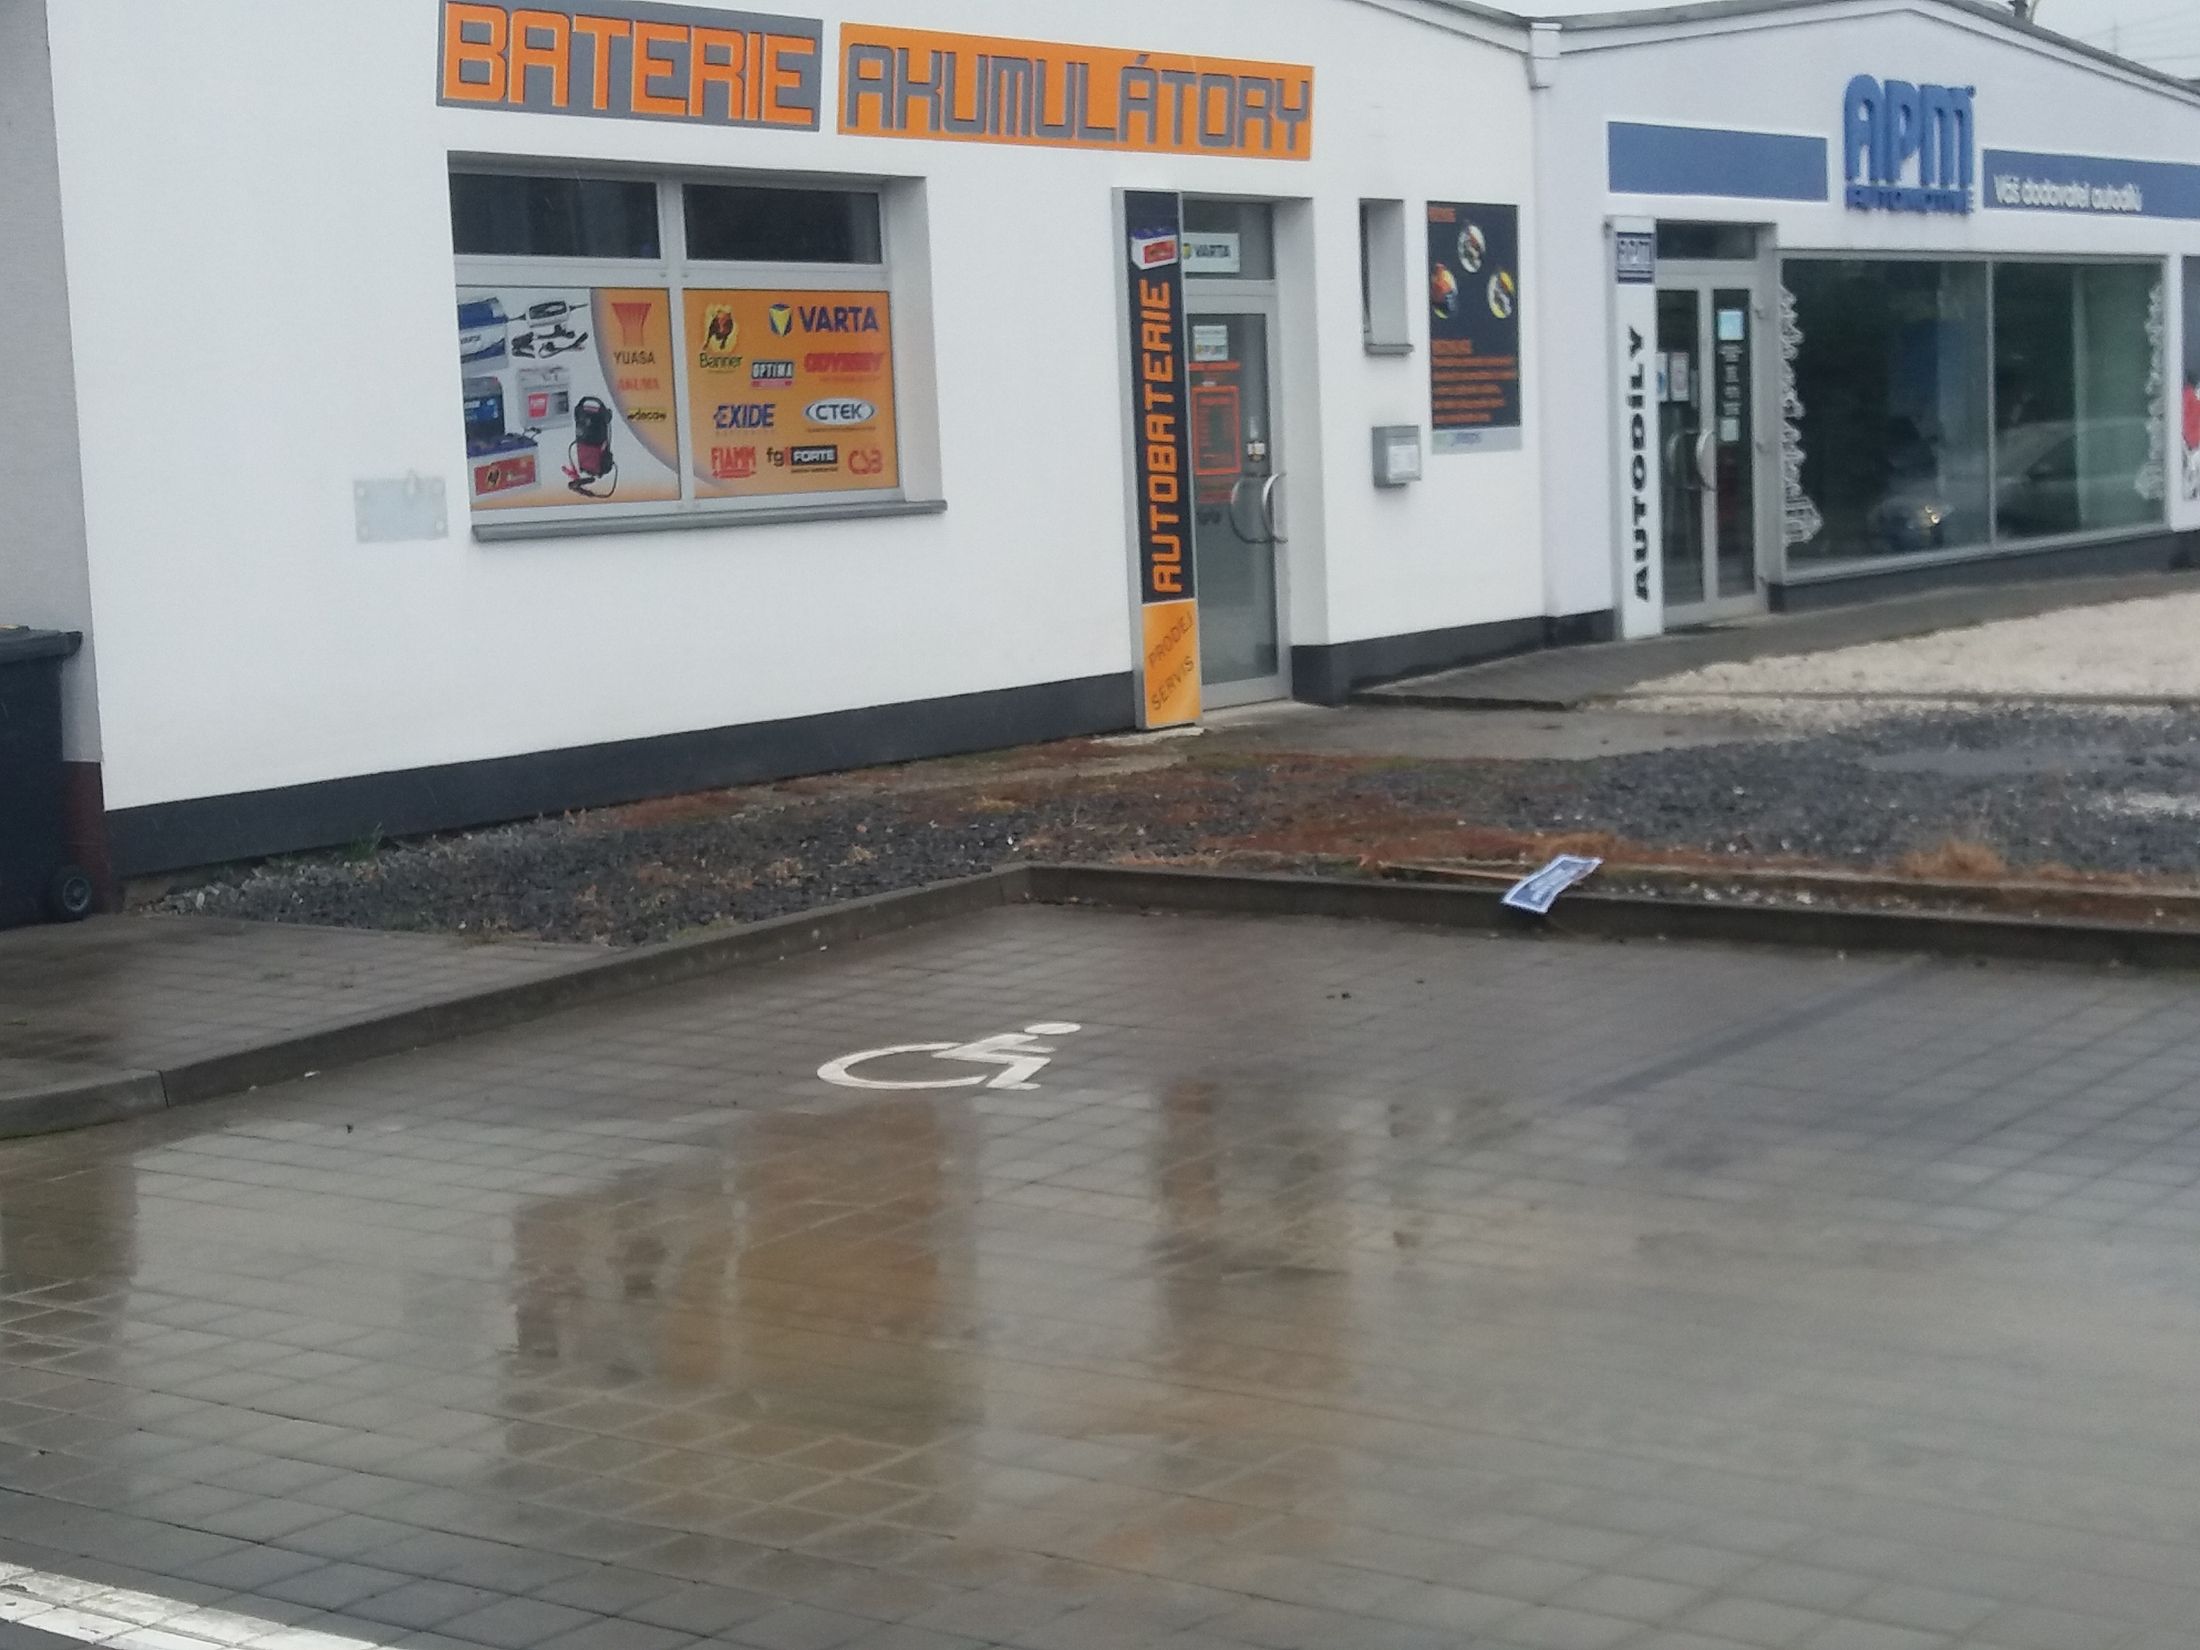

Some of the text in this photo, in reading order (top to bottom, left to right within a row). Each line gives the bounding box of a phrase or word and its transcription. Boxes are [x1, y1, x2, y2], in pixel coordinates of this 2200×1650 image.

[443, 2, 1309, 151] BATERIE AKUMULÁTORY
[1844, 74, 1974, 187] APM
[798, 306, 879, 333] VARTA
[613, 351, 656, 365] YUASA
[700, 353, 743, 369] Banner
[715, 404, 775, 429] EXIDE
[815, 404, 862, 421] CTEK
[1138, 279, 1182, 593] AUTOBATERIE
